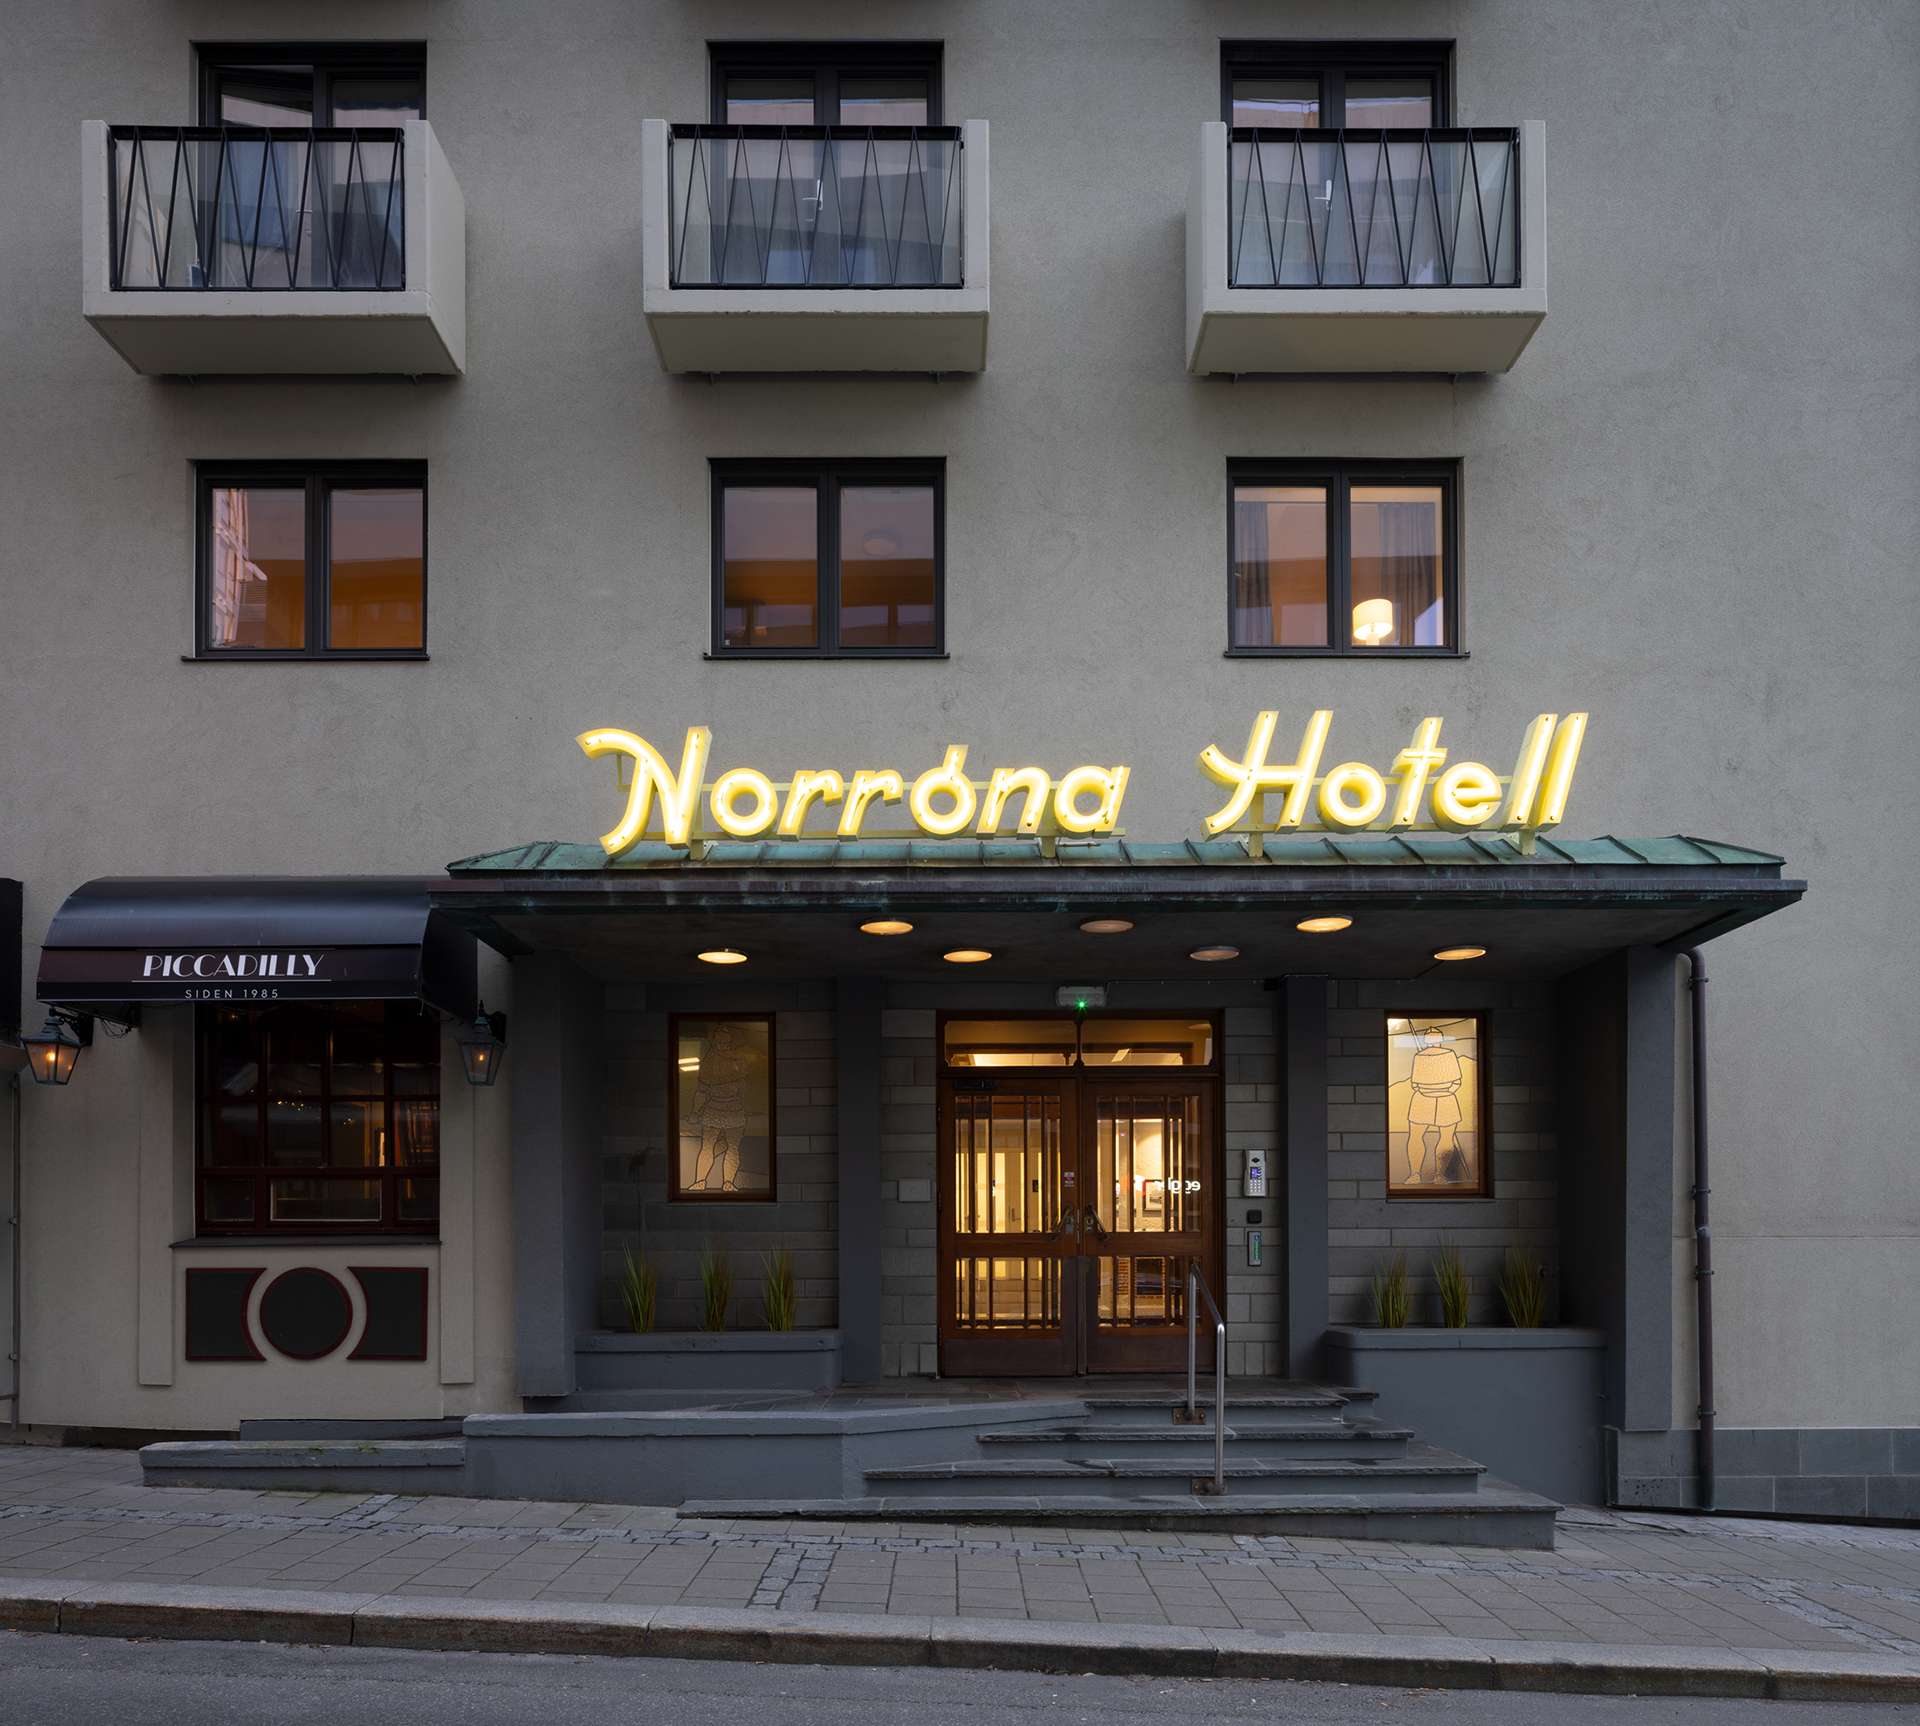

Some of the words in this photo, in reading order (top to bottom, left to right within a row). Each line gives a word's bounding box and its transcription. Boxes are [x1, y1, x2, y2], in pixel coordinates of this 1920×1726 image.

[1196, 710, 1589, 842] Hotell
[143, 954, 325, 978] PICCADILLY
[185, 989, 233, 999] SIDEN
[243, 988, 278, 998] 1985
